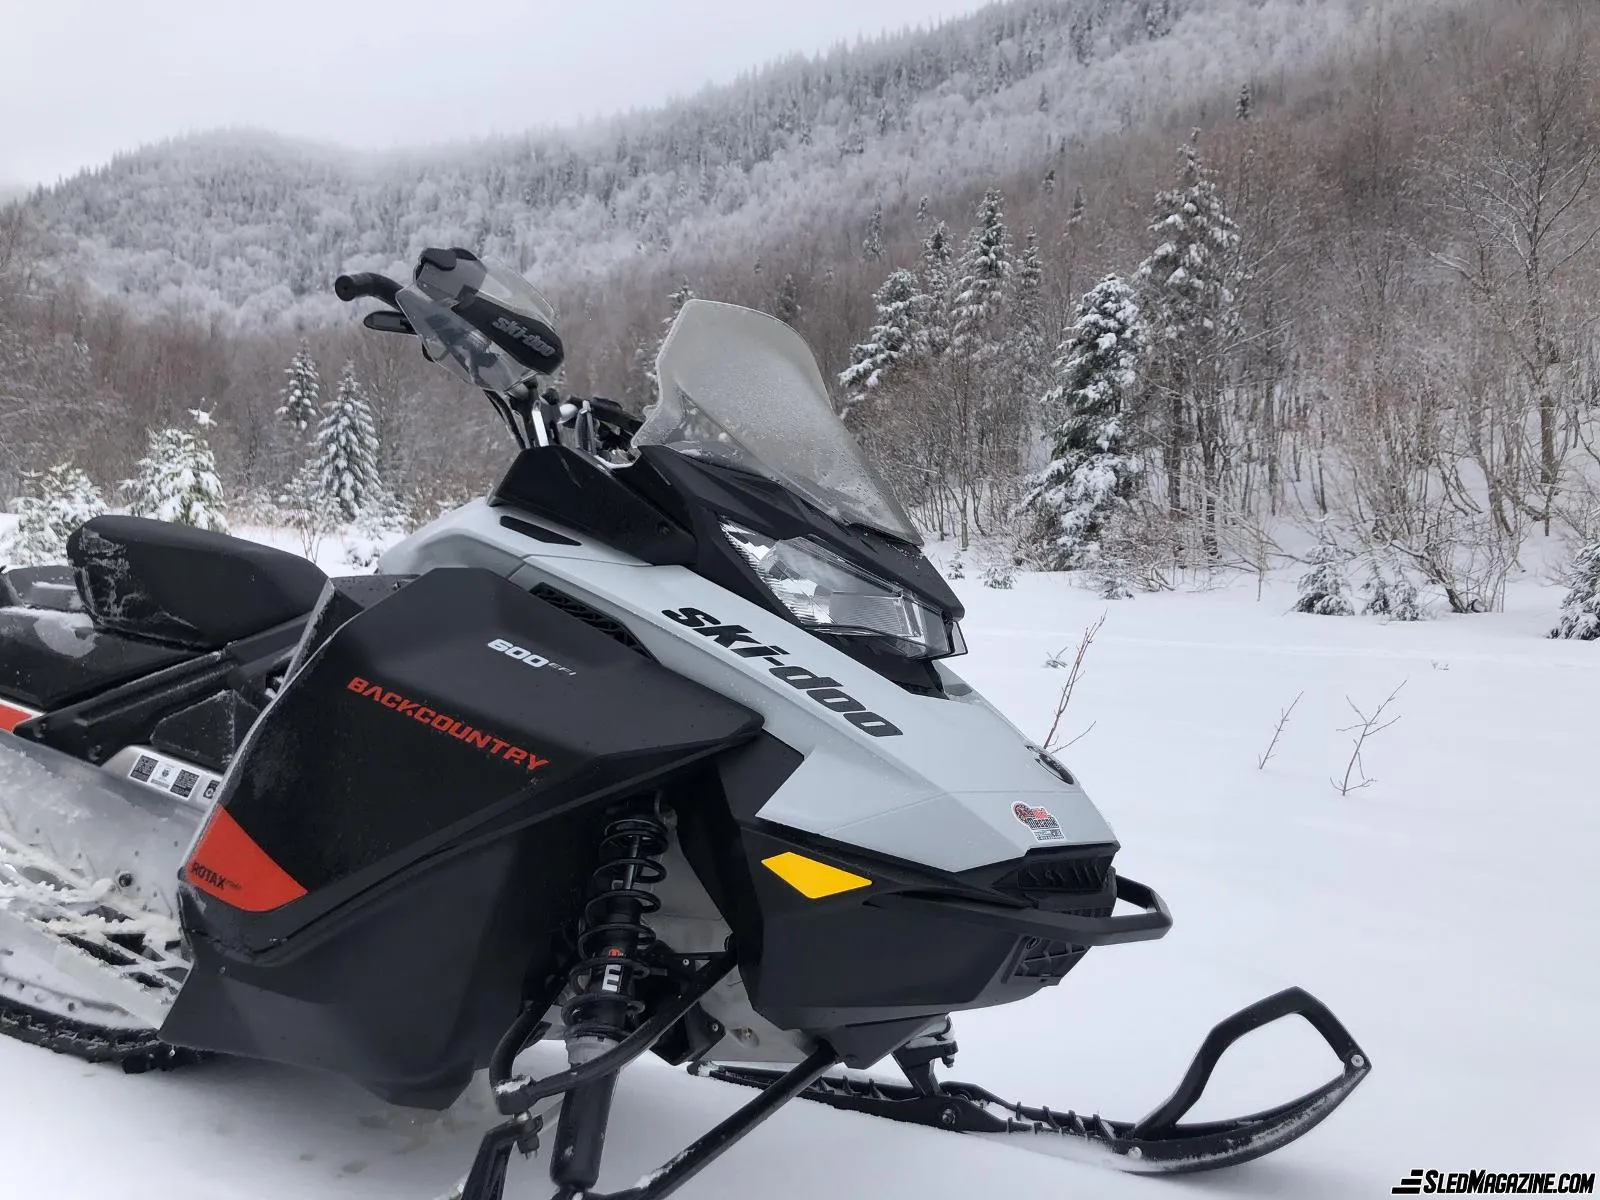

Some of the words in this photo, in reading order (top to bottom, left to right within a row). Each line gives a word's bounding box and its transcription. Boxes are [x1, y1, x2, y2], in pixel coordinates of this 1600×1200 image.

[487, 638, 550, 668] 600
[347, 676, 549, 770] BACKCOUNTRY
[191, 862, 226, 890] ROTAX
